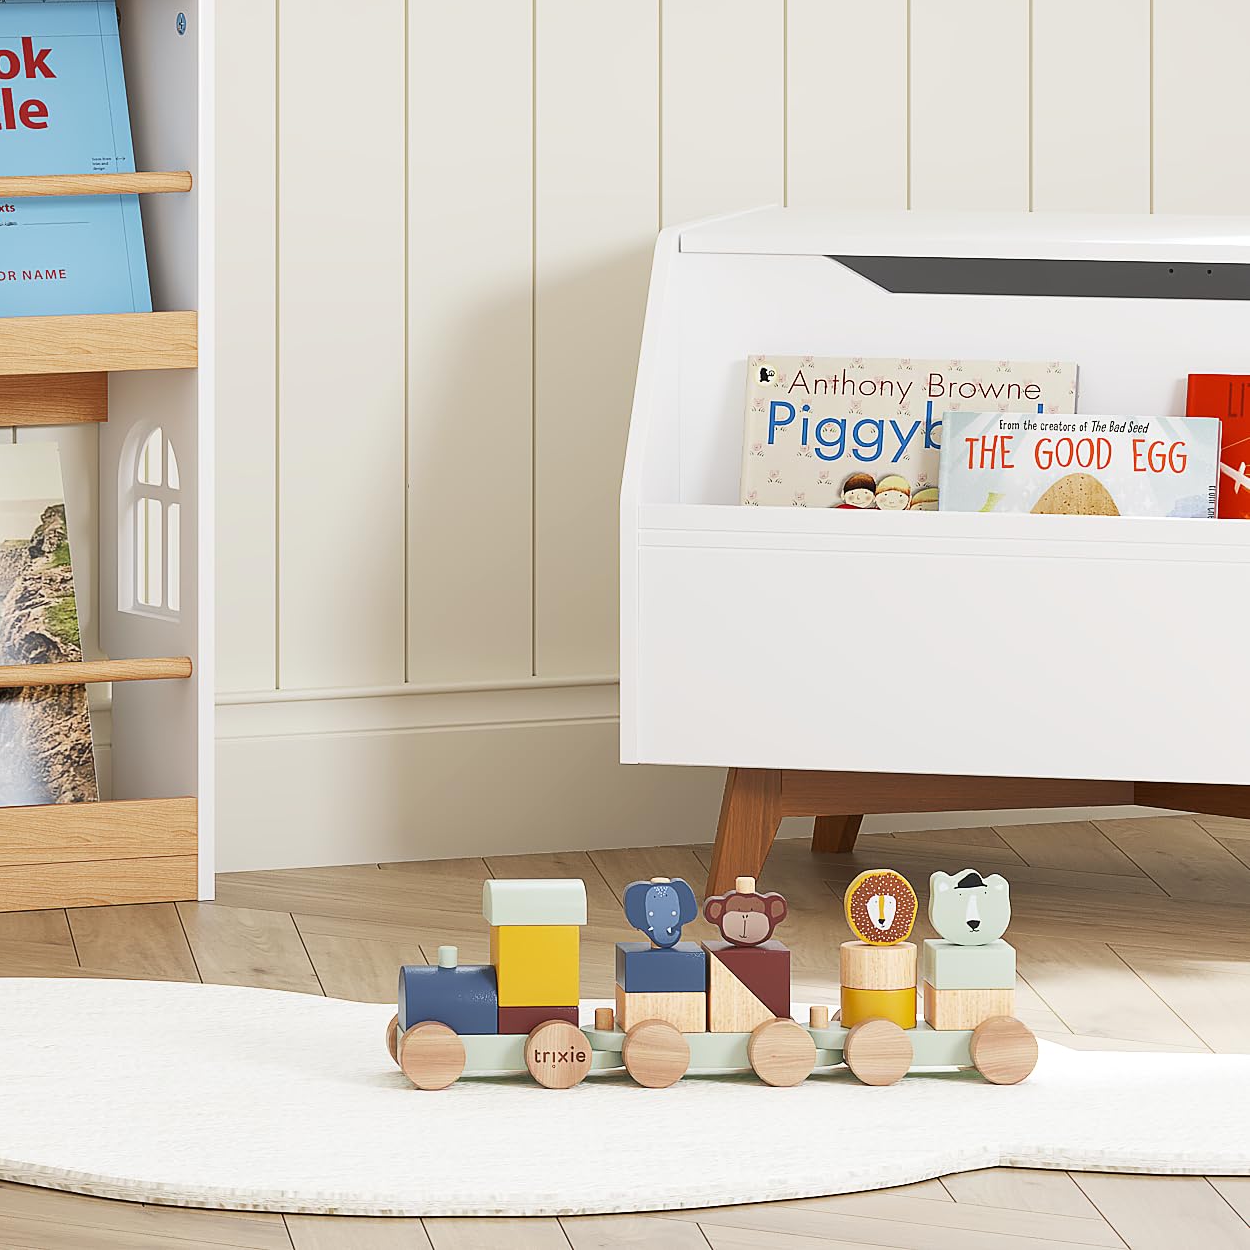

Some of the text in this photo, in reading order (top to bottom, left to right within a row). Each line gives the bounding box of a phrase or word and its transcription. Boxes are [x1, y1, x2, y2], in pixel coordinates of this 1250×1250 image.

[23, 269, 67, 281] NAME
[788, 370, 1041, 400] Anthony Browne
[767, 400, 1044, 463] Piggyb
[999, 419, 1150, 433] From the creators of The Bad Seed
[965, 435, 1188, 473] THE GOOD EGG
[534, 1045, 586, 1069] trixie
